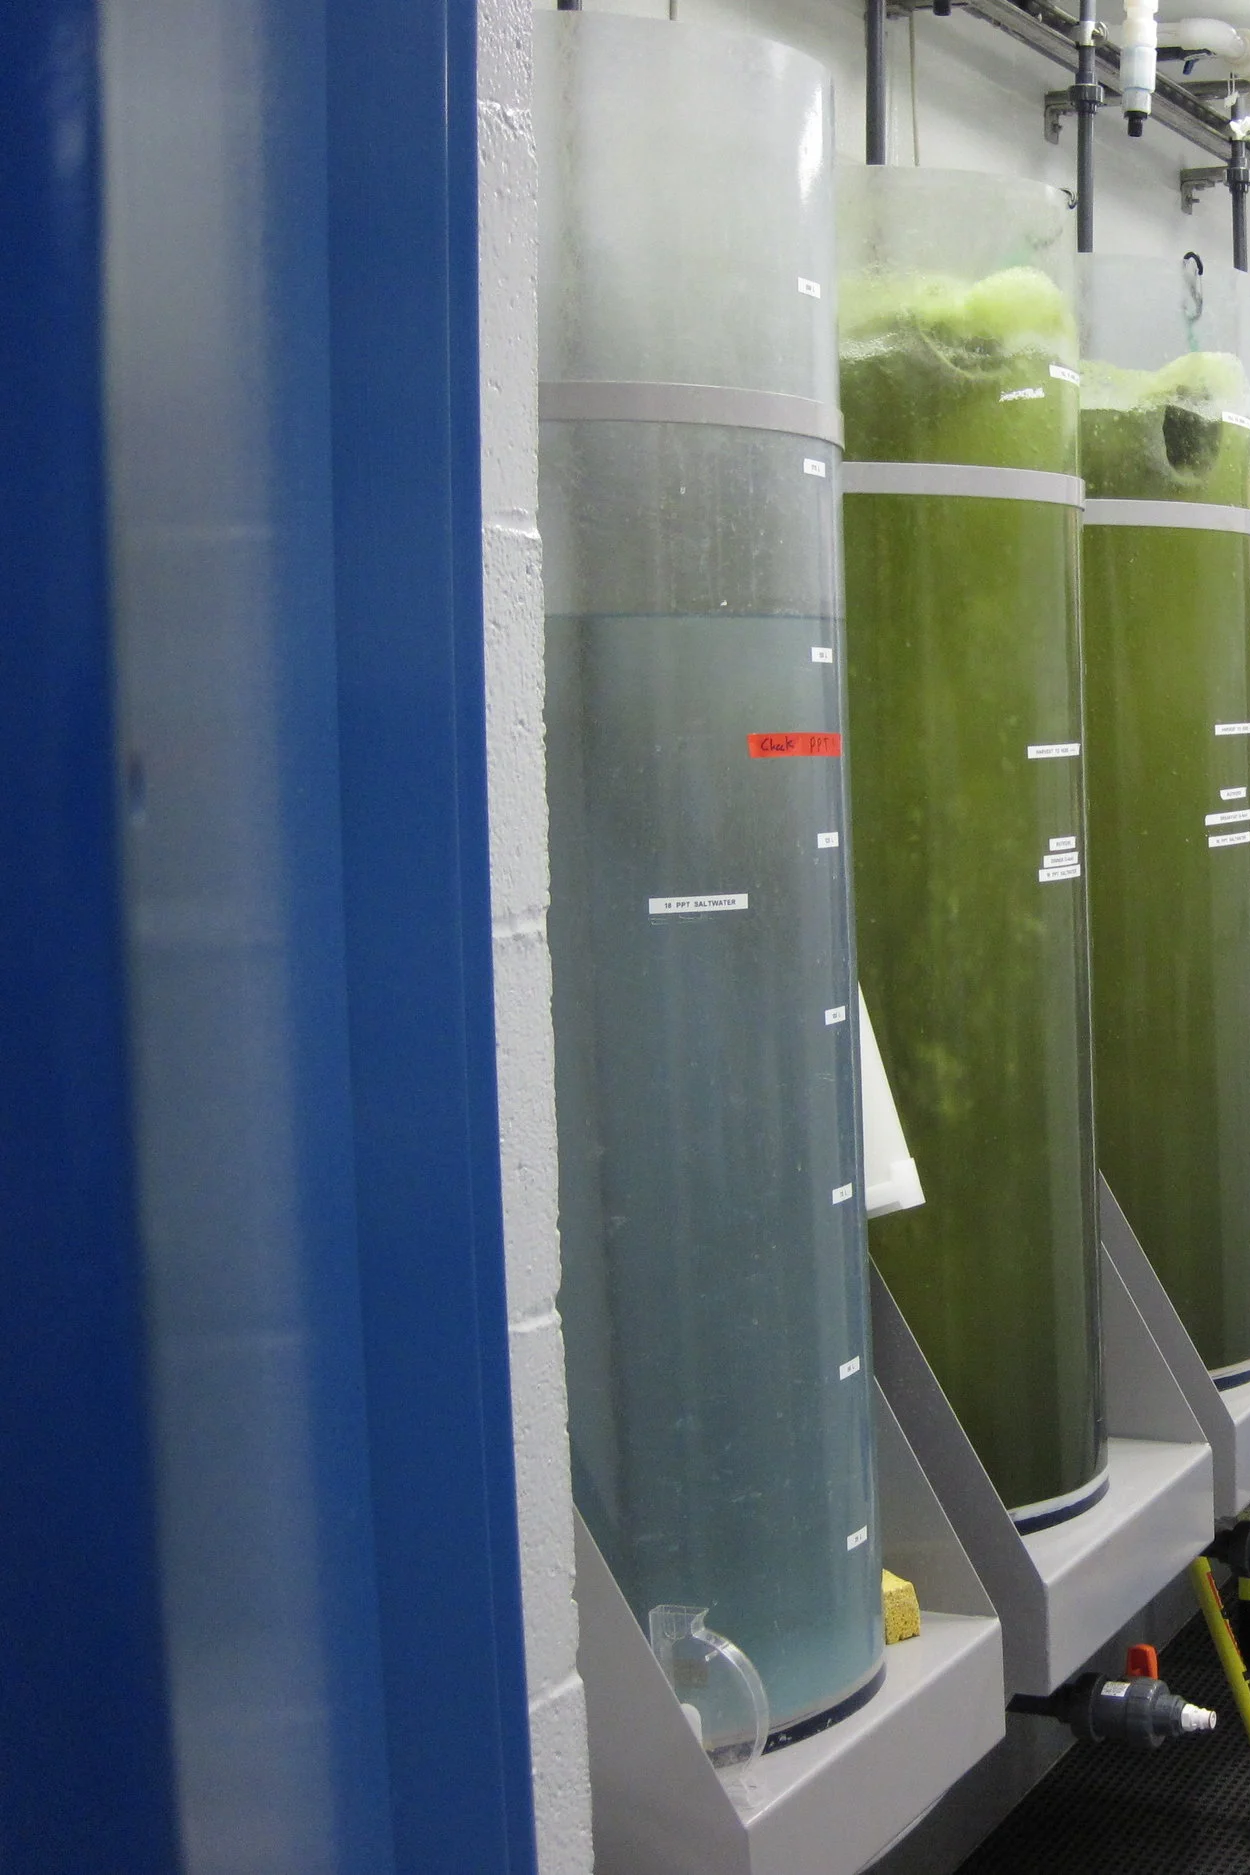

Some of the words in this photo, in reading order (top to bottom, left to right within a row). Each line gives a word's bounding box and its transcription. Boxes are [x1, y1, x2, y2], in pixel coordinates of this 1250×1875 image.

[760, 736, 794, 752] Check
[676, 901, 690, 909] PPT
[694, 899, 736, 908] SALTWATER
